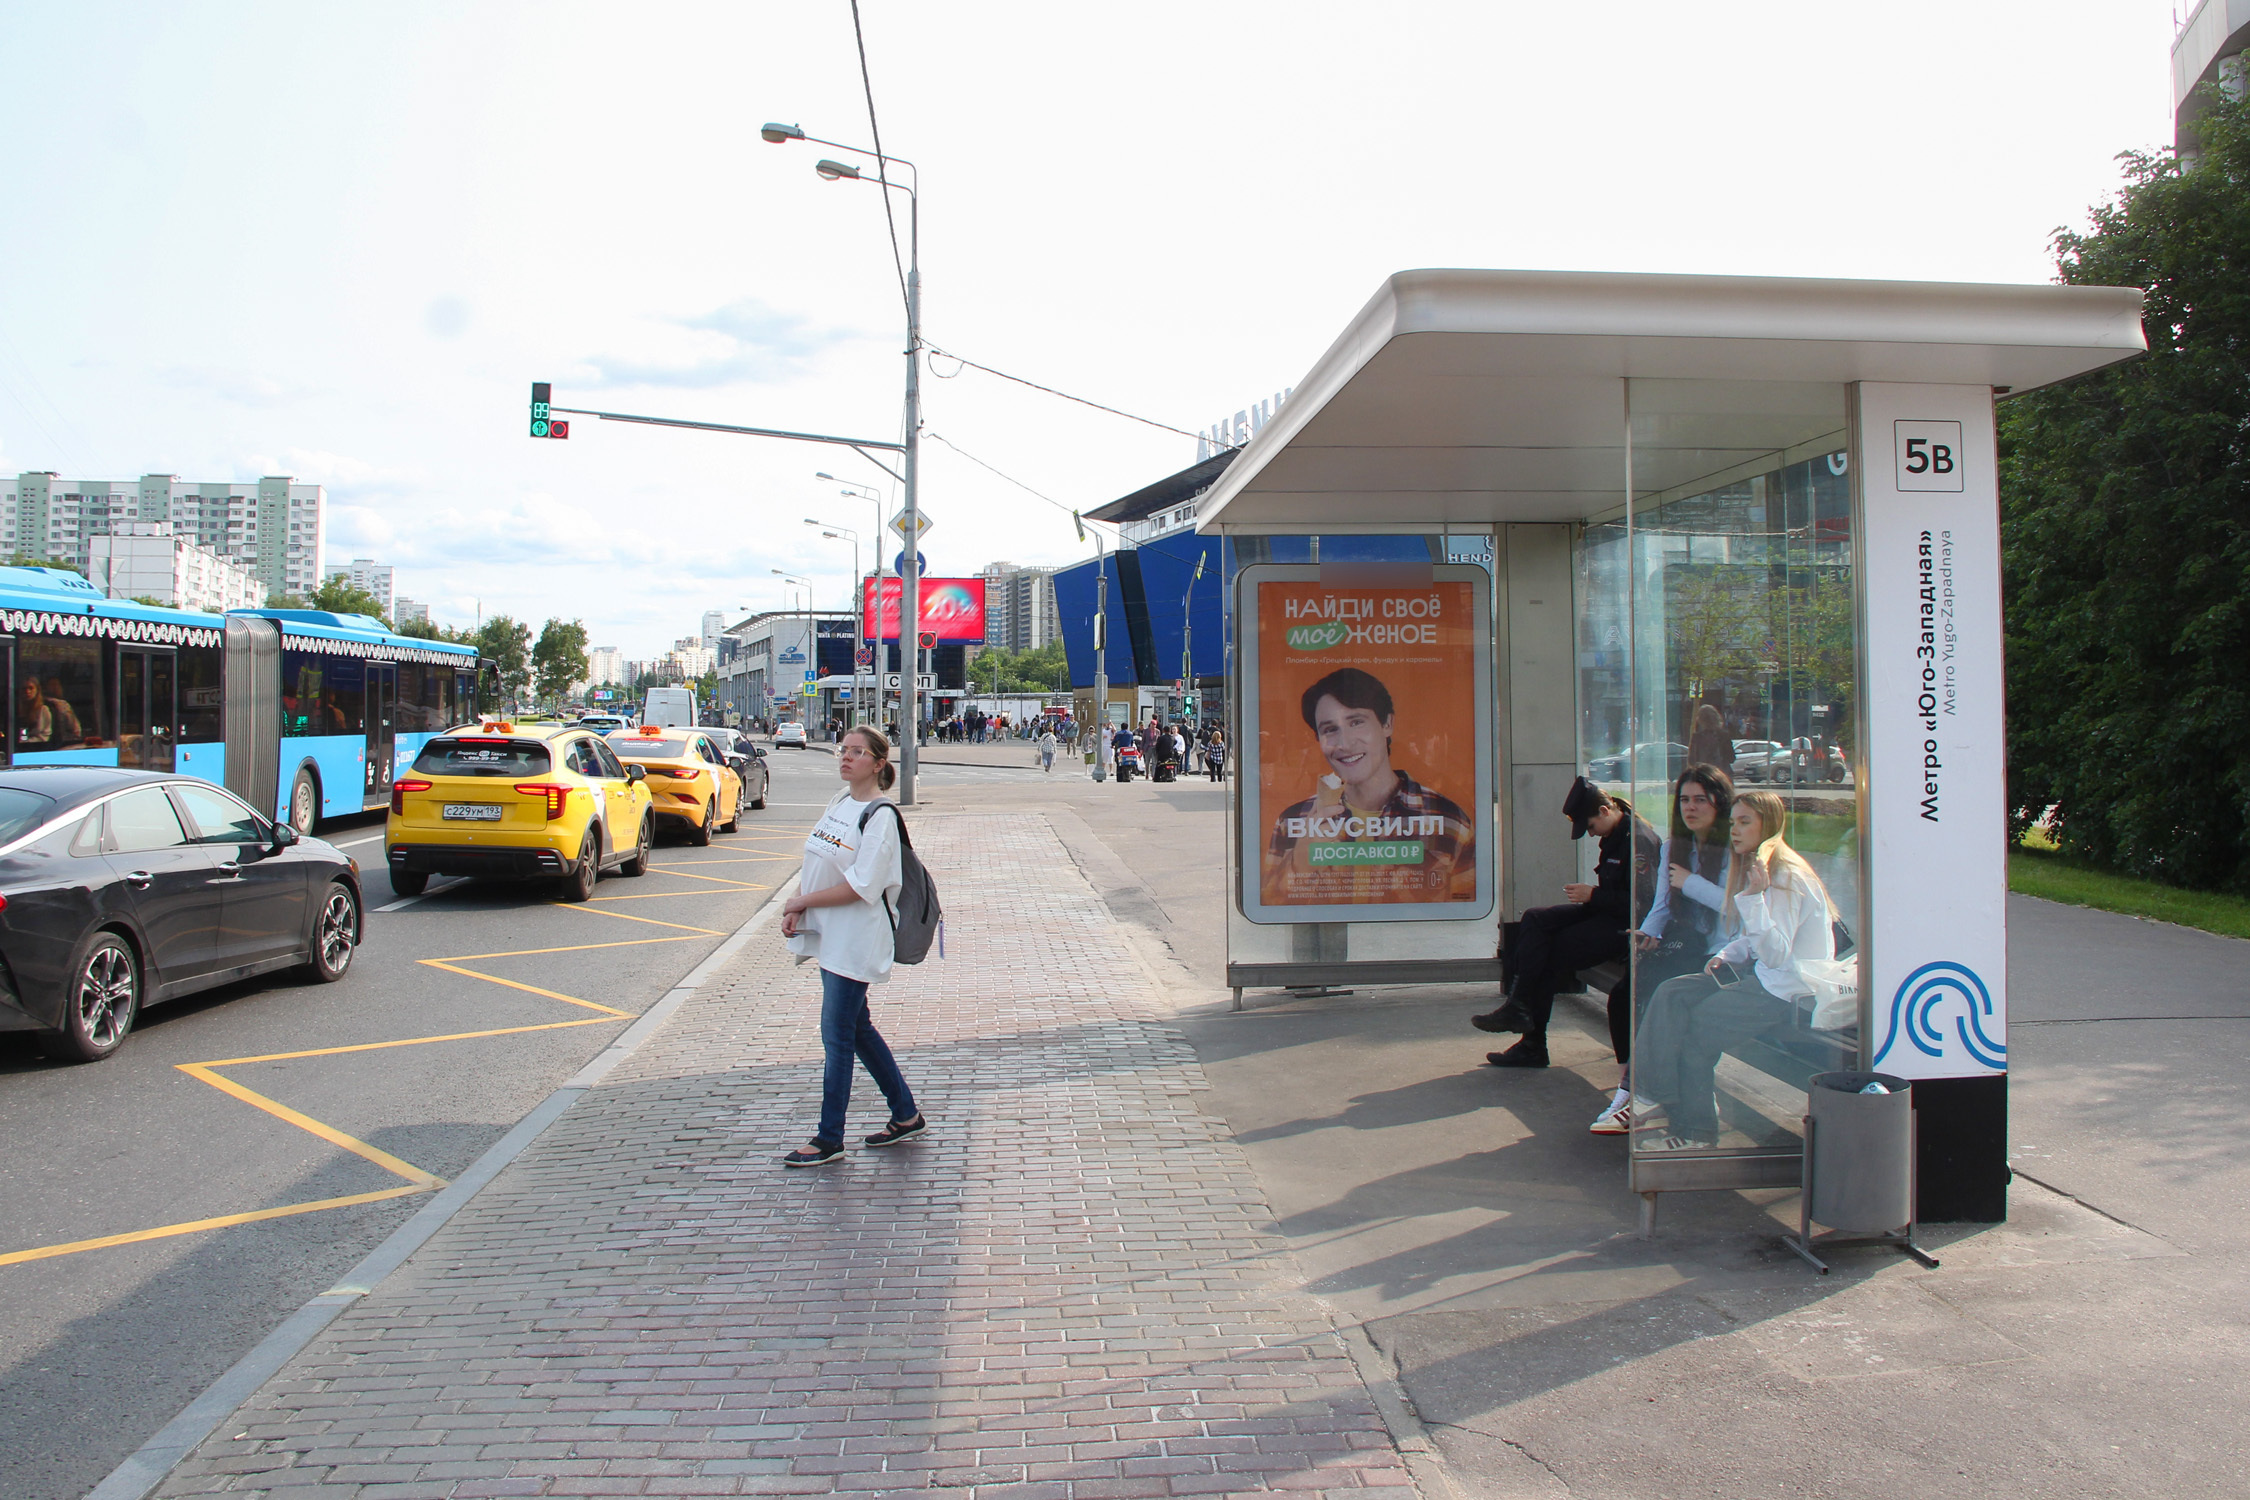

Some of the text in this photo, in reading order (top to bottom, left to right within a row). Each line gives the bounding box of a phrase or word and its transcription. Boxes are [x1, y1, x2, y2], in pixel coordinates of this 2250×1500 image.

[1905, 438, 1954, 474] 5В
[1285, 594, 1374, 622] НАЙДИ
[1939, 529, 1957, 716] Metro Yugo-Zapadnaya
[1917, 529, 1942, 823] Метро «Юго-Западная»
[1287, 815, 1444, 838] ВКУСВИЛЛ
